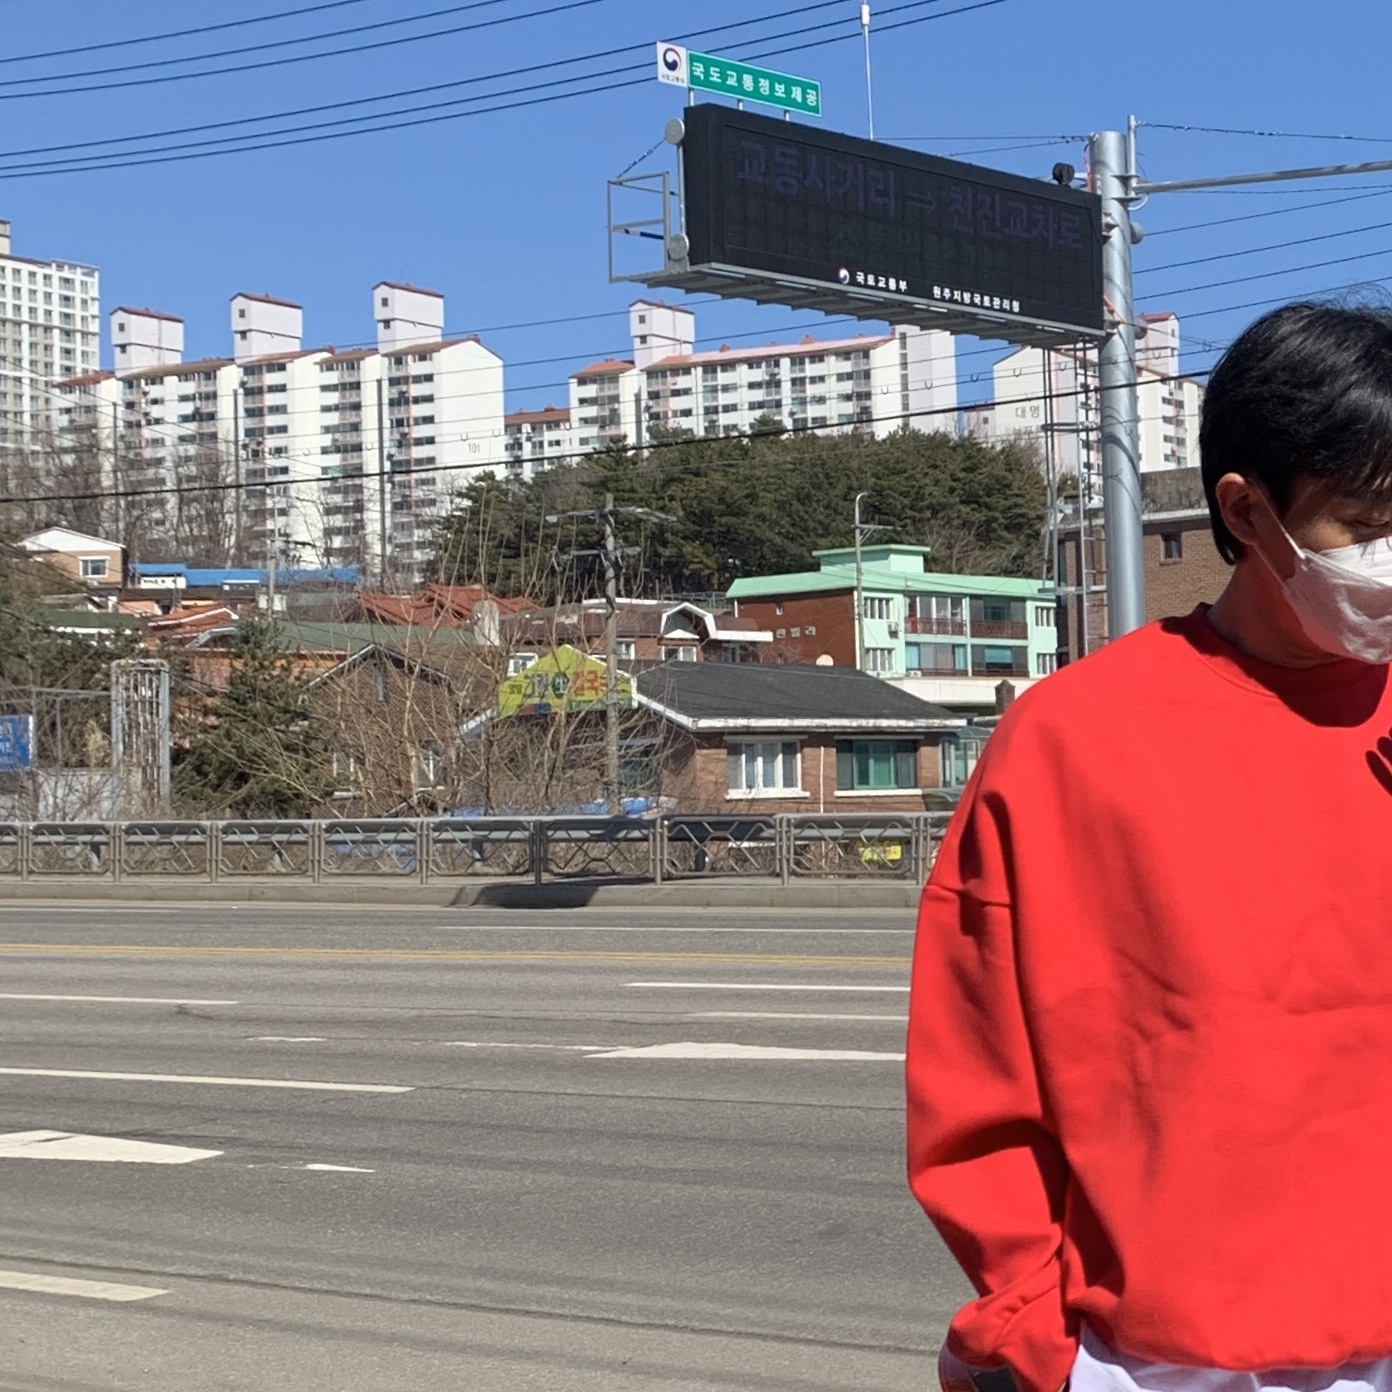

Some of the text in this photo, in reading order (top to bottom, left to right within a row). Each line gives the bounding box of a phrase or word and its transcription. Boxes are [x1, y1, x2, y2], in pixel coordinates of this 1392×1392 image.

[691, 61, 818, 107] 국도교통정보제공
[738, 140, 897, 217] 교동사거리
[855, 271, 1021, 314] 국토교통부 원주지방국토관리청
